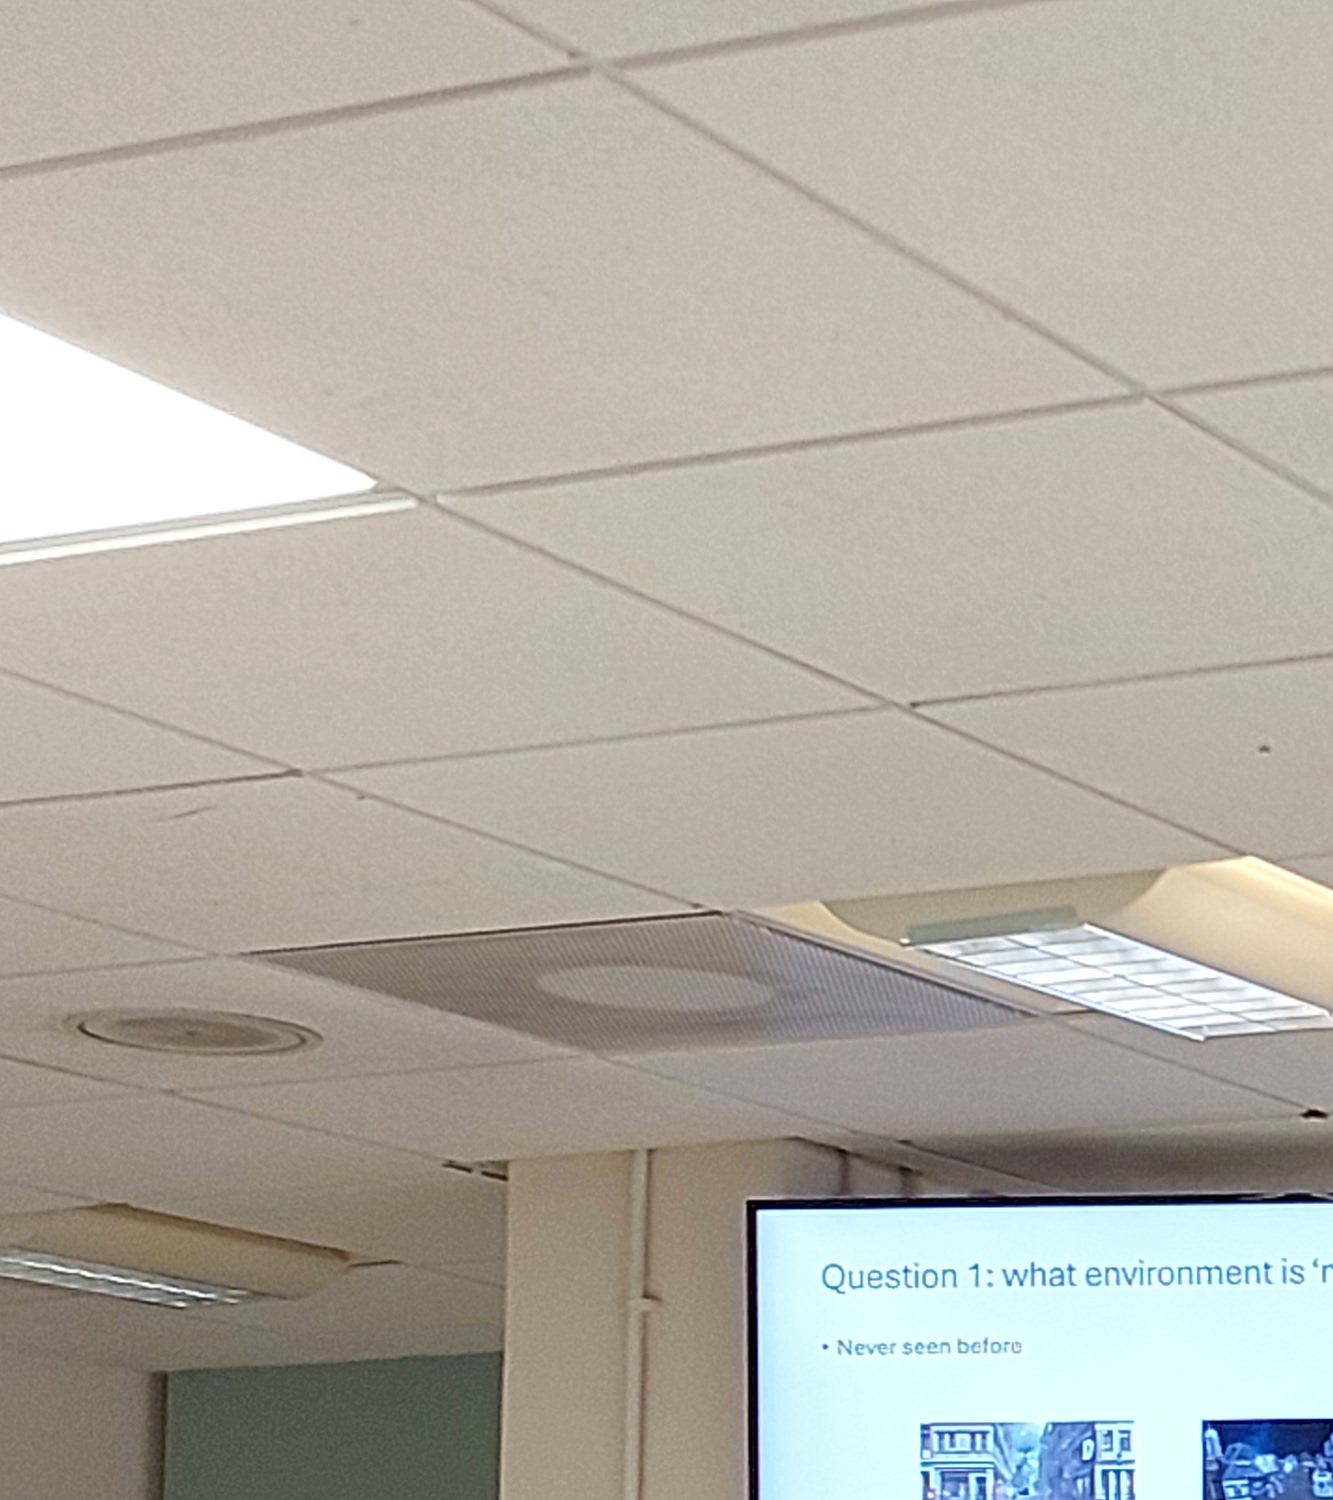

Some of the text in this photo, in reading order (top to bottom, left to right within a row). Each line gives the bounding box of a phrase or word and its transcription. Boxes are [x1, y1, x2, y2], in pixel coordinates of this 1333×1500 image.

[821, 1262, 958, 1295] Question
[968, 1263, 995, 1288] 1:
[1001, 1261, 1078, 1288] what
[1085, 1259, 1275, 1287] environment
[1281, 1257, 1306, 1285] is
[837, 1337, 1023, 1356] Never seen before
